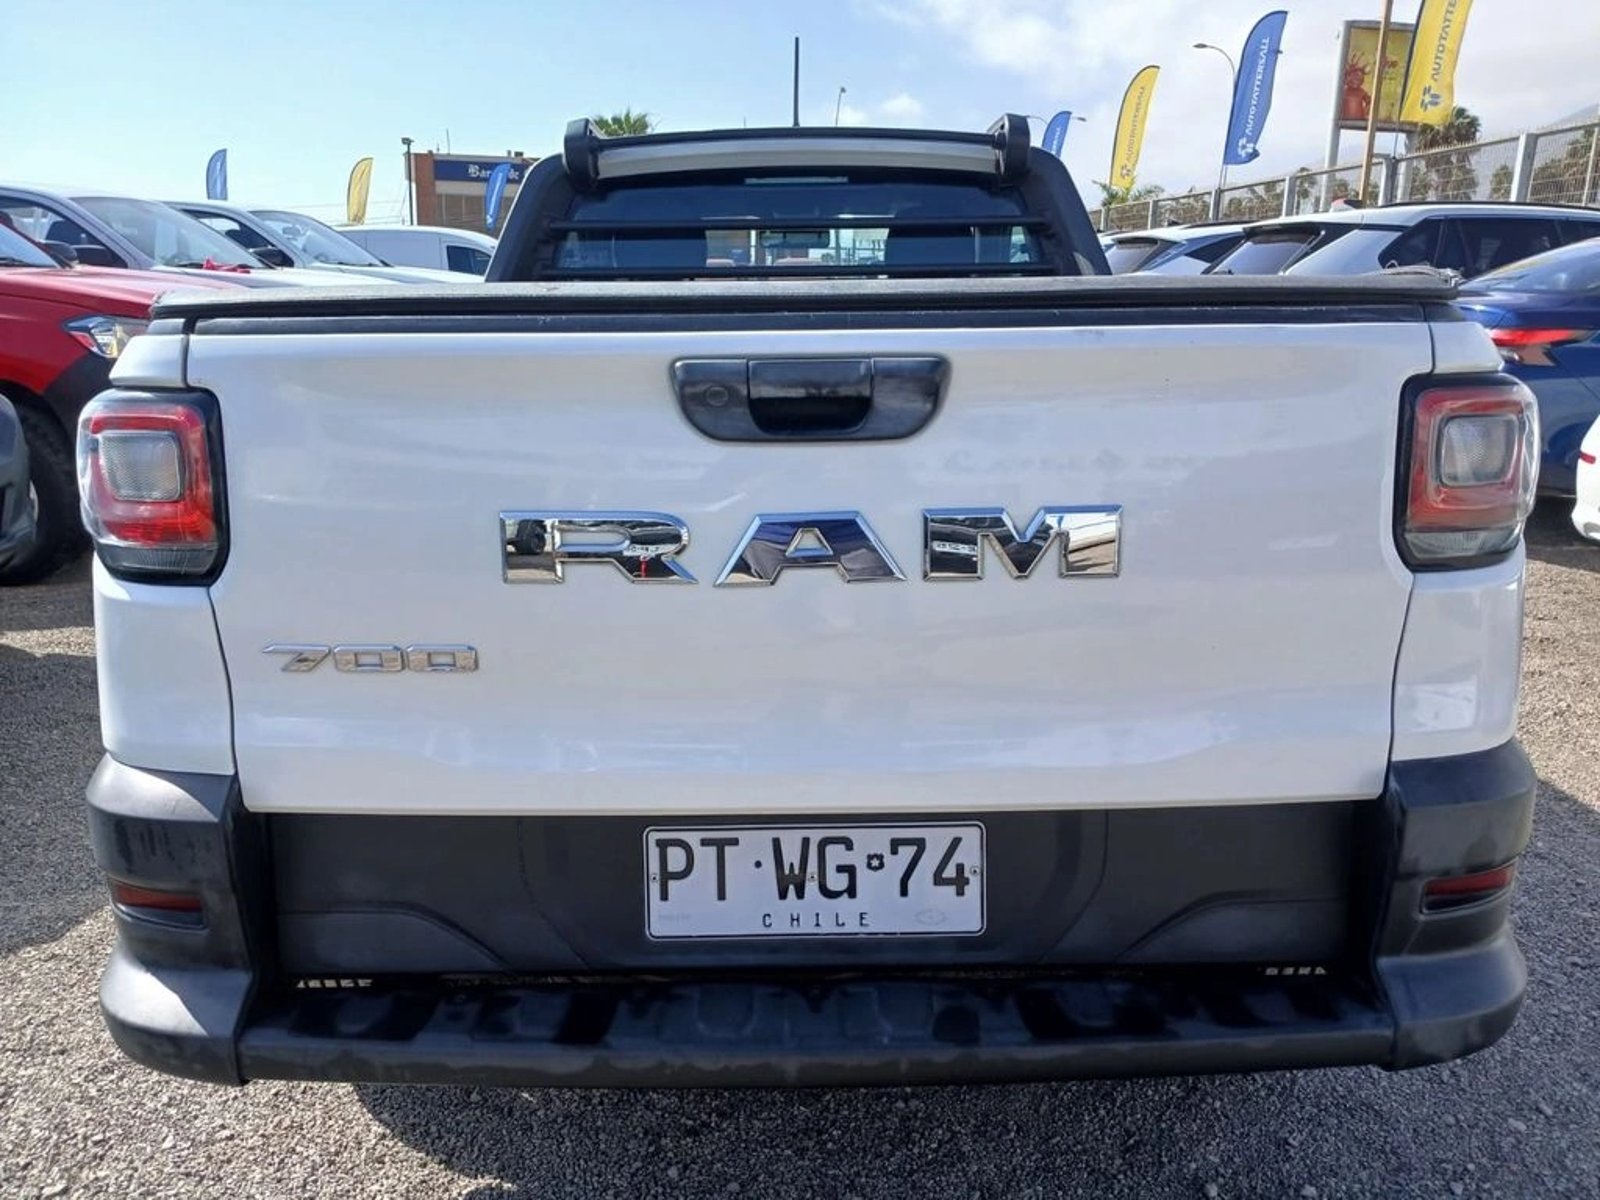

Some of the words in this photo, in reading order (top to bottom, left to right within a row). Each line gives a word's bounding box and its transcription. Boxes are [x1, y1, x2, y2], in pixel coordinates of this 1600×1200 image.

[1246, 37, 1270, 135] AUTOTATTERSALL
[499, 504, 1123, 587] RAM
[262, 642, 479, 673] 700
[761, 911, 871, 928] CHILE
